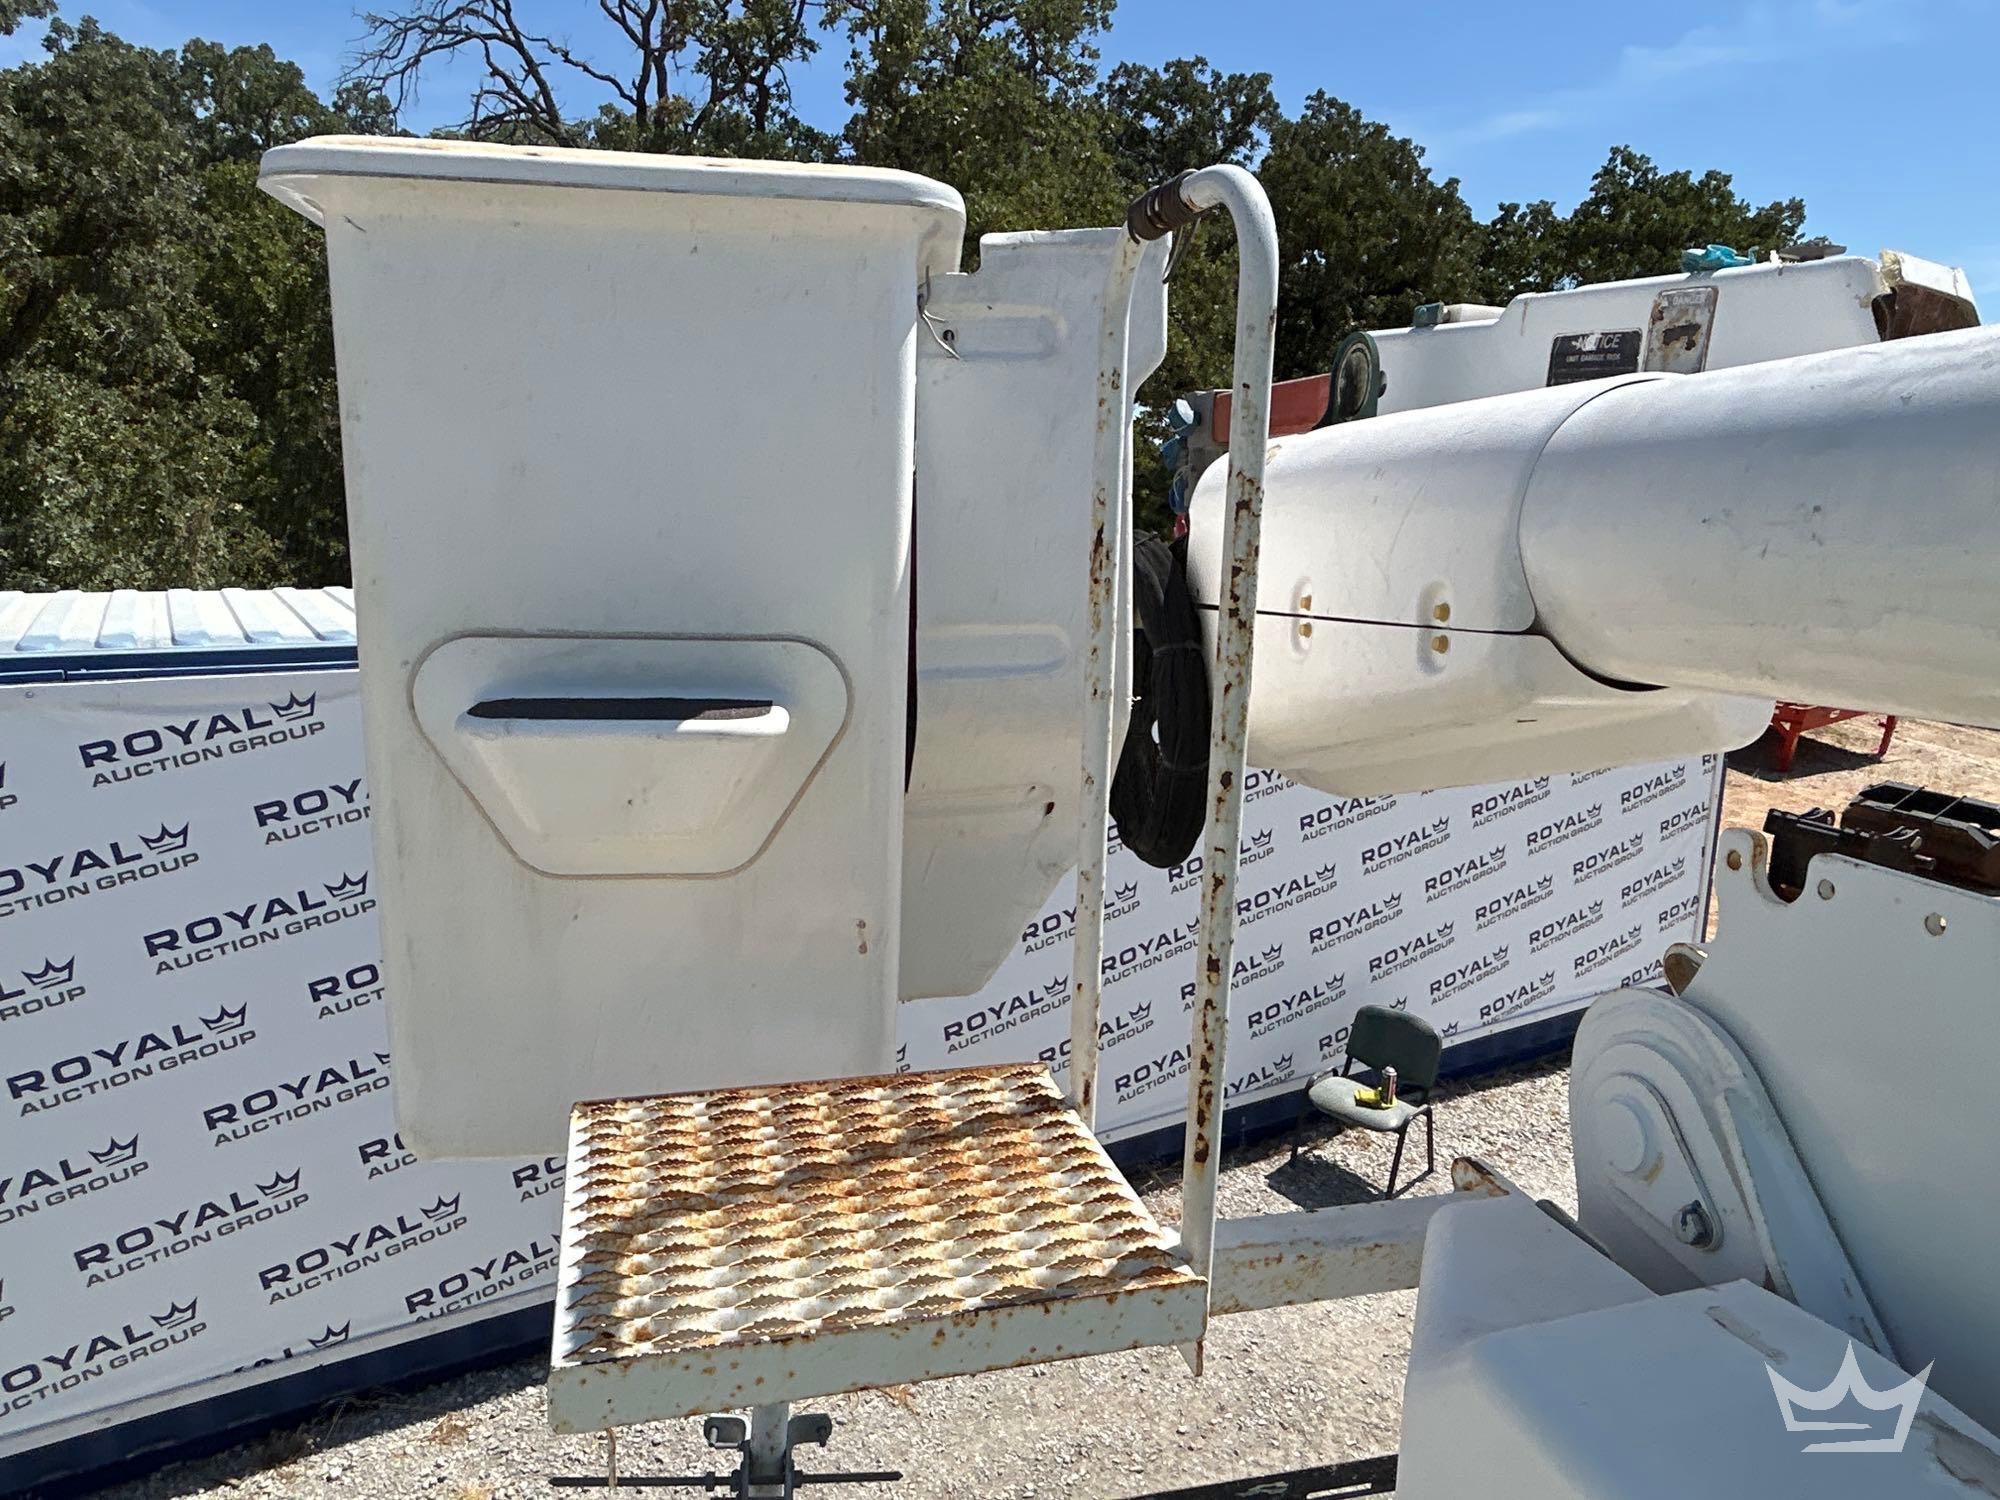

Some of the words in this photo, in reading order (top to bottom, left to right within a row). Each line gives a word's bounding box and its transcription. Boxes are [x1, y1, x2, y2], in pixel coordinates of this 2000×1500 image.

[79, 708, 272, 768] ROYAL
[92, 746, 223, 787] AUCTION
[229, 721, 325, 754] GROUP
[254, 779, 369, 827] ROY
[1245, 783, 1283, 803] CTION
[1471, 783, 1534, 818] ROYAL
[1472, 804, 1516, 829] AUCTION
[1517, 790, 1550, 809] GROUP
[1620, 773, 1672, 805] ROYAL
[1622, 793, 1658, 814] AUCTION
[1659, 779, 1686, 797] GROUP
[1300, 798, 1376, 831] ROYAL
[1302, 818, 1354, 843] AUCTION
[1357, 800, 1397, 822] GROUP
[1527, 811, 1587, 847] ROYAL
[1659, 821, 1694, 842] AUCTION
[1660, 802, 1708, 833] ROYAL
[1240, 847, 1274, 867] ROUP
[1361, 826, 1432, 865] ROYAL
[1363, 850, 1412, 876] AUCTION
[1414, 833, 1450, 854] GROUP
[1528, 832, 1569, 856] AUCTION
[1570, 818, 1603, 837] GROUP
[0, 842, 143, 896] OYAL
[1425, 855, 1489, 892] ROYAL
[1573, 841, 1629, 875] ROYAL
[1574, 863, 1614, 885] AUCTION
[1615, 847, 1643, 867] GROUP
[0, 882, 90, 917] CTION
[96, 853, 199, 890] GROUP
[1170, 874, 1204, 895] AUCT
[1237, 874, 1316, 915] ROYAL
[1426, 876, 1471, 903] AUCTION
[1473, 860, 1507, 881] GROUP
[1621, 866, 1672, 899] ROYAL
[1622, 885, 1657, 909] AUCTION
[1658, 870, 1685, 889] GROUP
[1103, 900, 1140, 924] ROUP
[1239, 900, 1293, 927] AUCTION
[1296, 880, 1337, 904] GROUP
[1475, 884, 1538, 921] ROYAL
[1477, 907, 1519, 931] AUCTION
[1521, 890, 1554, 911] GROUP
[1659, 895, 1699, 924] ROYA
[143, 890, 327, 957] ROYAL
[155, 927, 280, 975] AUCTION
[285, 899, 376, 935] GROUP
[1022, 906, 1077, 942] ROY
[1024, 926, 1076, 955] AUCTIO
[1309, 903, 1383, 944] ROYAL
[1312, 928, 1363, 955] AUCTION
[1365, 909, 1403, 932] GROUP
[1529, 907, 1588, 945] ROYAL
[1530, 931, 1570, 955] AUCTION
[1572, 914, 1603, 935] GROUP
[1101, 928, 1186, 975] ROYAL
[1103, 953, 1163, 987] AUCTION
[1165, 937, 1198, 960] GROU
[1369, 932, 1437, 973] ROYAL
[1370, 957, 1418, 983] AUCTION
[1420, 936, 1455, 959] GROUP
[1574, 934, 1628, 970] ROYAL
[1575, 957, 1612, 979] AUCTION
[1614, 938, 1642, 958] GROUP
[1241, 961, 1285, 987] GROUP
[1430, 955, 1493, 995] ROYAL
[1431, 977, 1474, 1005] AUCTION
[1476, 960, 1510, 982] GROUP
[1621, 959, 1663, 988] ROYA
[0, 986, 86, 1021] ROUP
[318, 987, 384, 1019] AUCT
[944, 990, 1044, 1041] ROYAL
[1247, 983, 1326, 1029] ROYAL
[1250, 1009, 1303, 1040] AUCTION
[1306, 989, 1346, 1013] GROUP
[1480, 981, 1539, 1020] ROYAL
[1482, 1003, 1522, 1026] AUCTION
[1524, 985, 1555, 1007] GROUP
[948, 1017, 1016, 1054] AUCTION
[1020, 995, 1071, 1023] GROUP
[1108, 1019, 1154, 1051] GROUP
[6, 1023, 202, 1100] ROYAL
[21, 1064, 153, 1117] AUCTION
[159, 1030, 256, 1071] GROUP
[1224, 1066, 1274, 1098] YAL
[203, 1060, 378, 1131] ROYAL
[1118, 1069, 1177, 1104] AUCTION
[214, 1095, 332, 1147] AUCTION
[337, 1076, 390, 1107] GRO
[45, 1161, 149, 1206] GROUP
[73, 1192, 259, 1272] ROYAL
[86, 1231, 211, 1288] AUCTION
[217, 1193, 309, 1237] GROUP
[259, 1215, 423, 1290] ROYAL
[269, 1251, 380, 1305] AUCTION
[385, 1216, 467, 1257] GROUP
[405, 1240, 553, 1314] ROYAL
[415, 1275, 514, 1323] AUCTION
[519, 1255, 559, 1281] GRO
[1, 1325, 153, 1393] OYAL
[109, 1322, 207, 1370] GROUP
